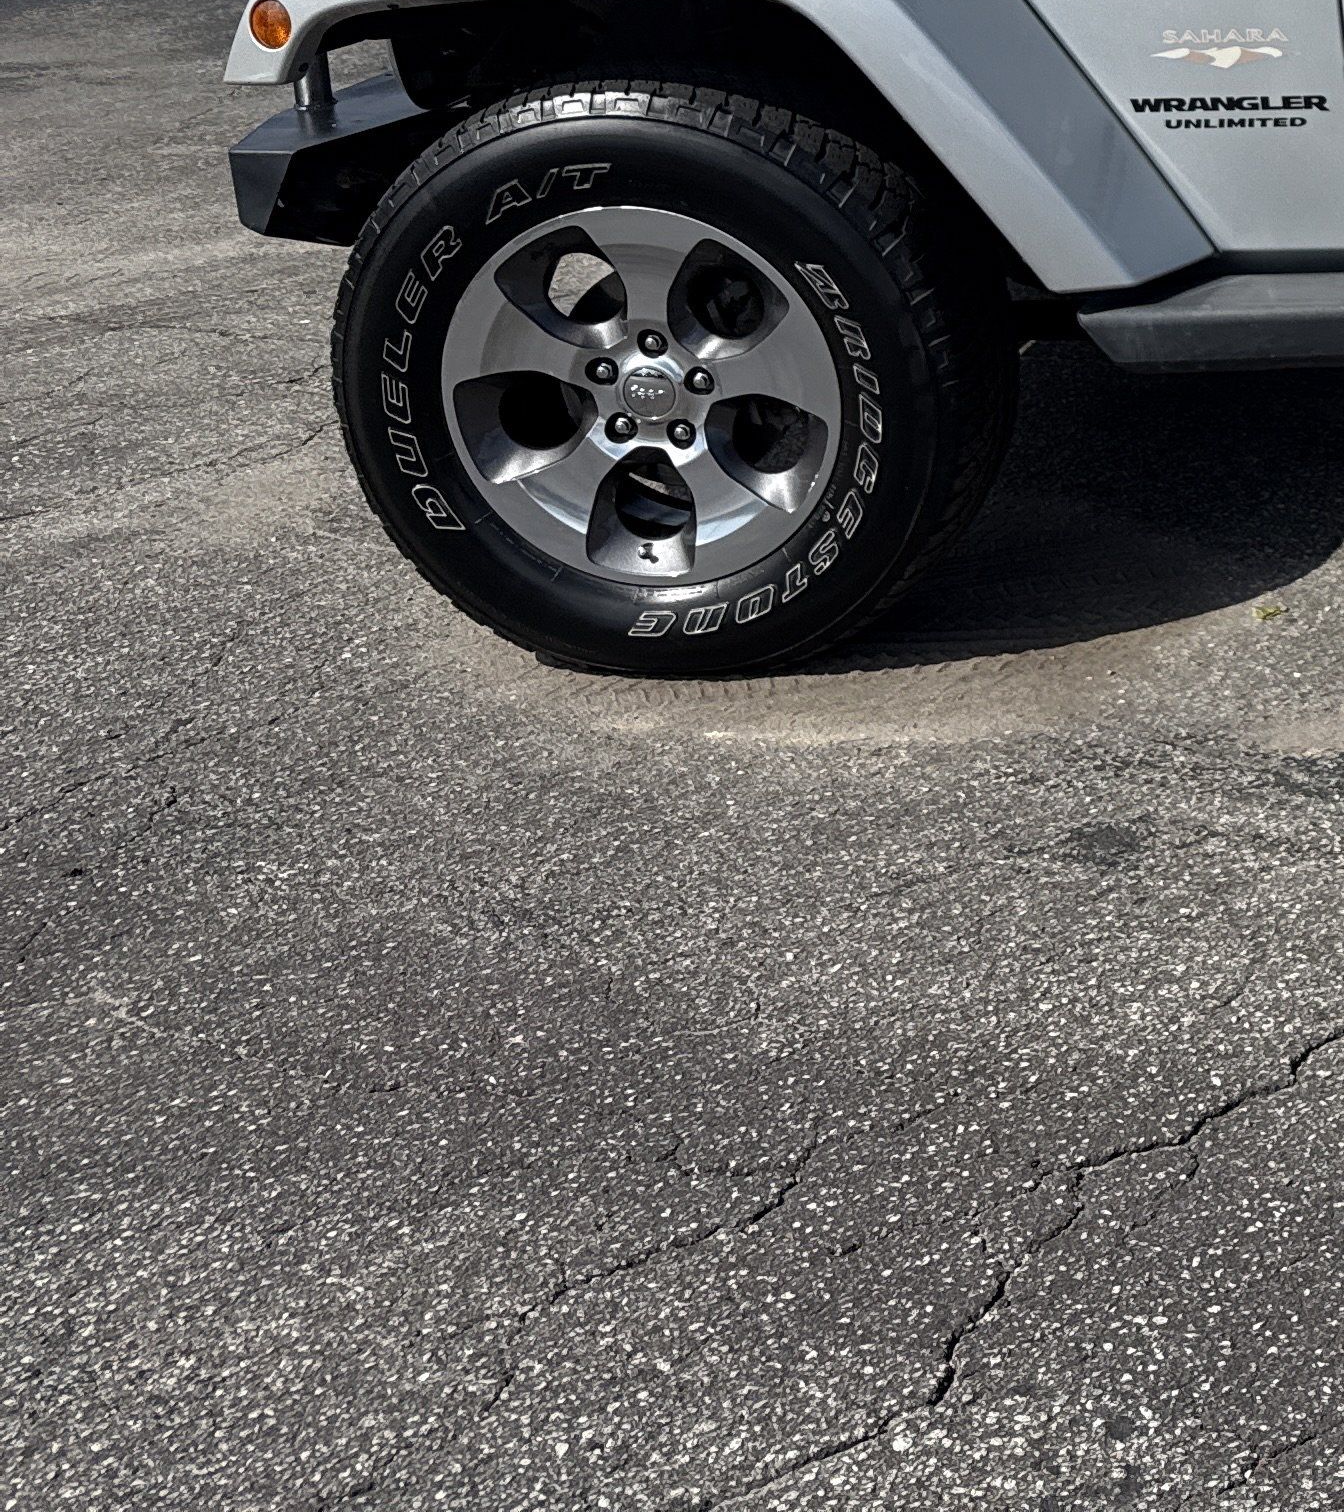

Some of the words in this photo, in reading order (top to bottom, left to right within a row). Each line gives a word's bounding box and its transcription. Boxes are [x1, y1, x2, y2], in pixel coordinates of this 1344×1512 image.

[1162, 28, 1289, 44] SAHARA
[1130, 94, 1330, 113] WRANGLER
[1165, 116, 1308, 129] UNLIMITED
[379, 224, 467, 532] DUELER
[486, 162, 612, 223] A/T
[627, 259, 885, 637] BRIDGESTONE
